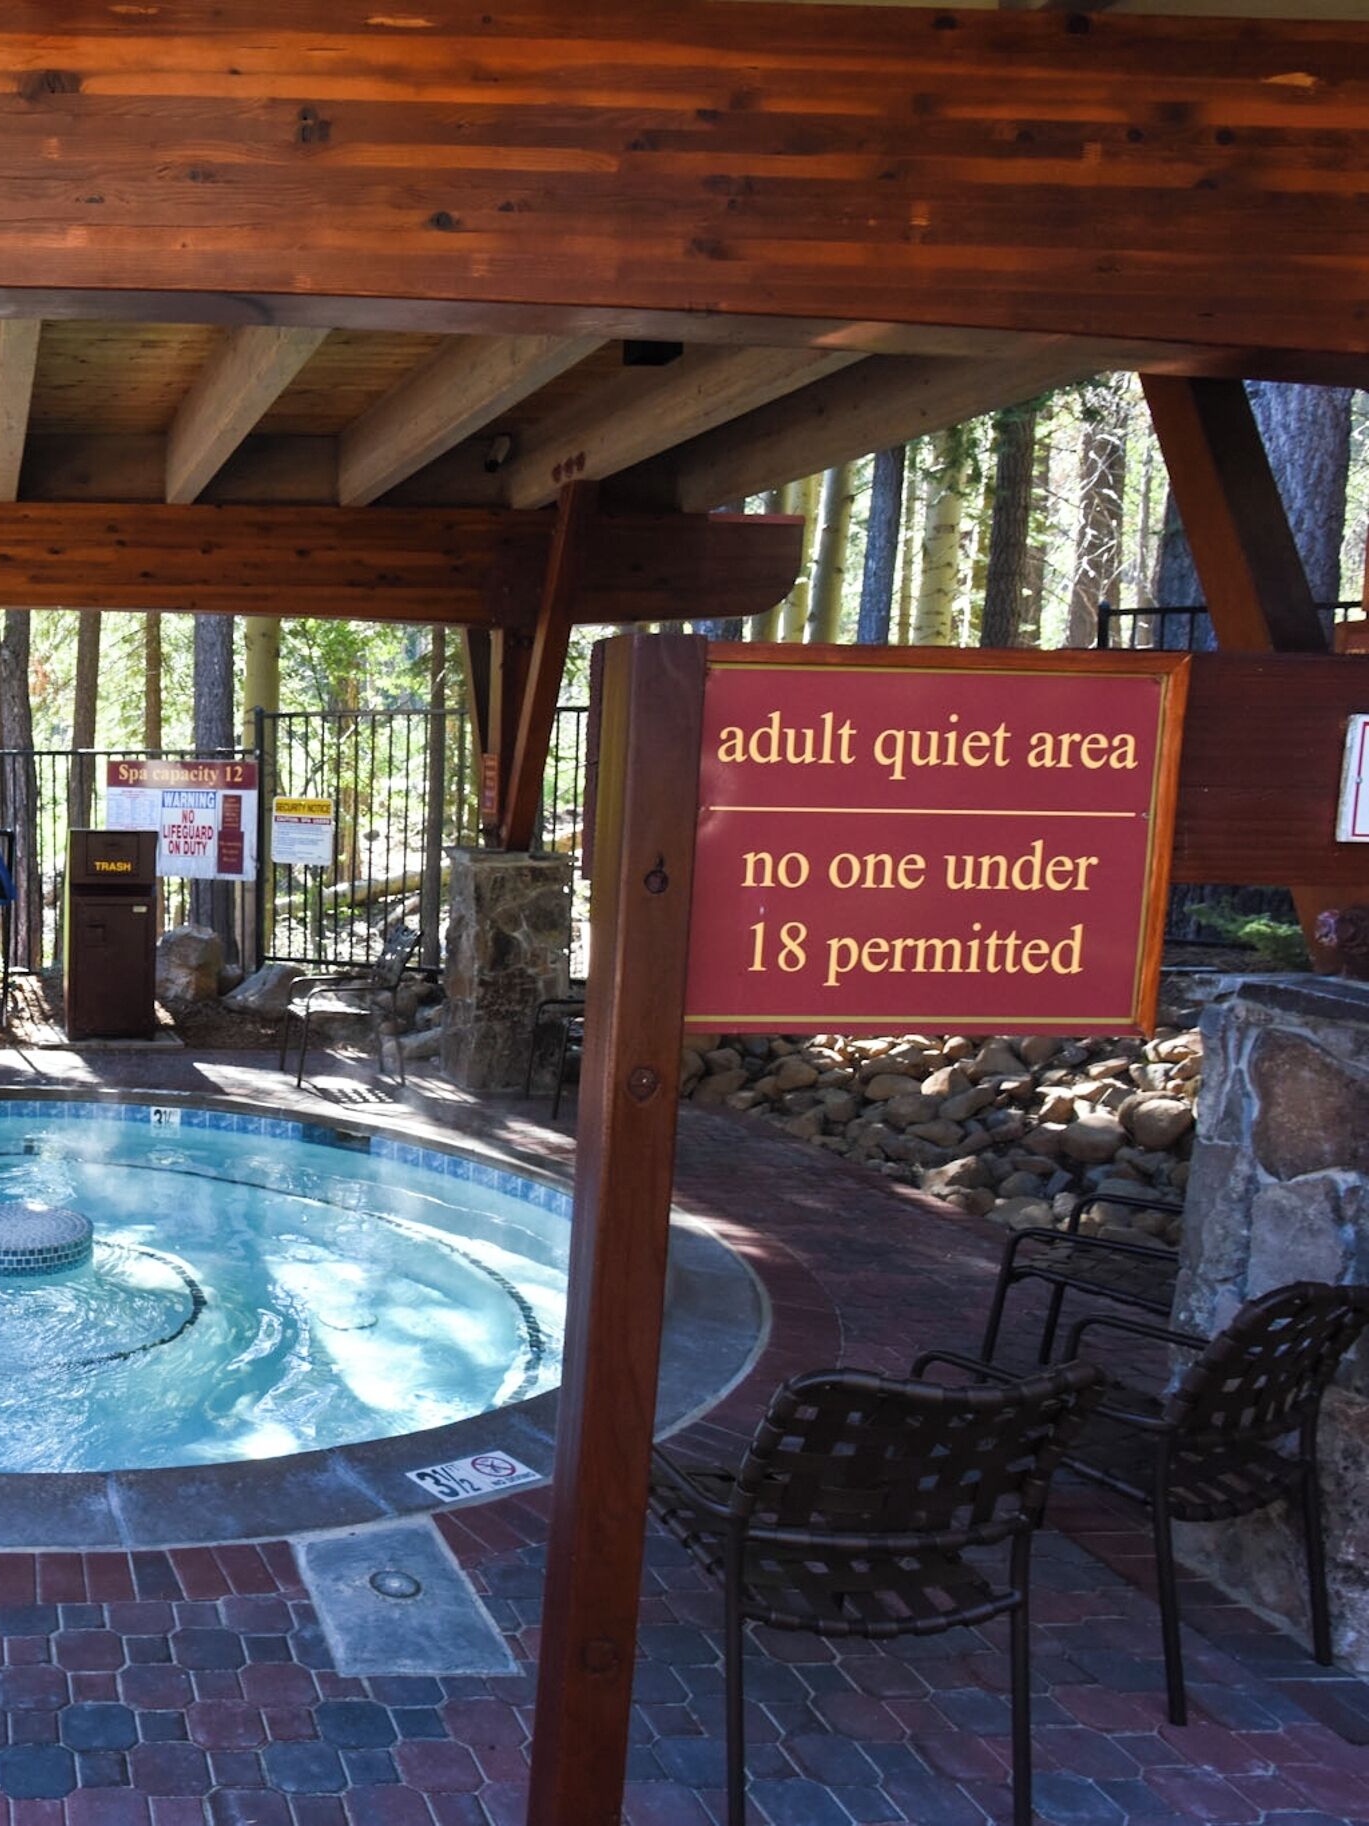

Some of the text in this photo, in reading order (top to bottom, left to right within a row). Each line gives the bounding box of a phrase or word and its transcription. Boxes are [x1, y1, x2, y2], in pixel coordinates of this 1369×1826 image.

[716, 710, 1138, 780] adult quiet area
[118, 764, 243, 785] Spa capacity 12
[163, 791, 215, 808] WARNING
[181, 810, 195, 823] NO
[163, 825, 214, 840] LIFEGUARD
[168, 841, 181, 855] ON
[184, 841, 208, 856] DUTY
[94, 861, 132, 872] TRASH
[741, 840, 1098, 891] no one under
[747, 920, 1085, 986] 18 permitted
